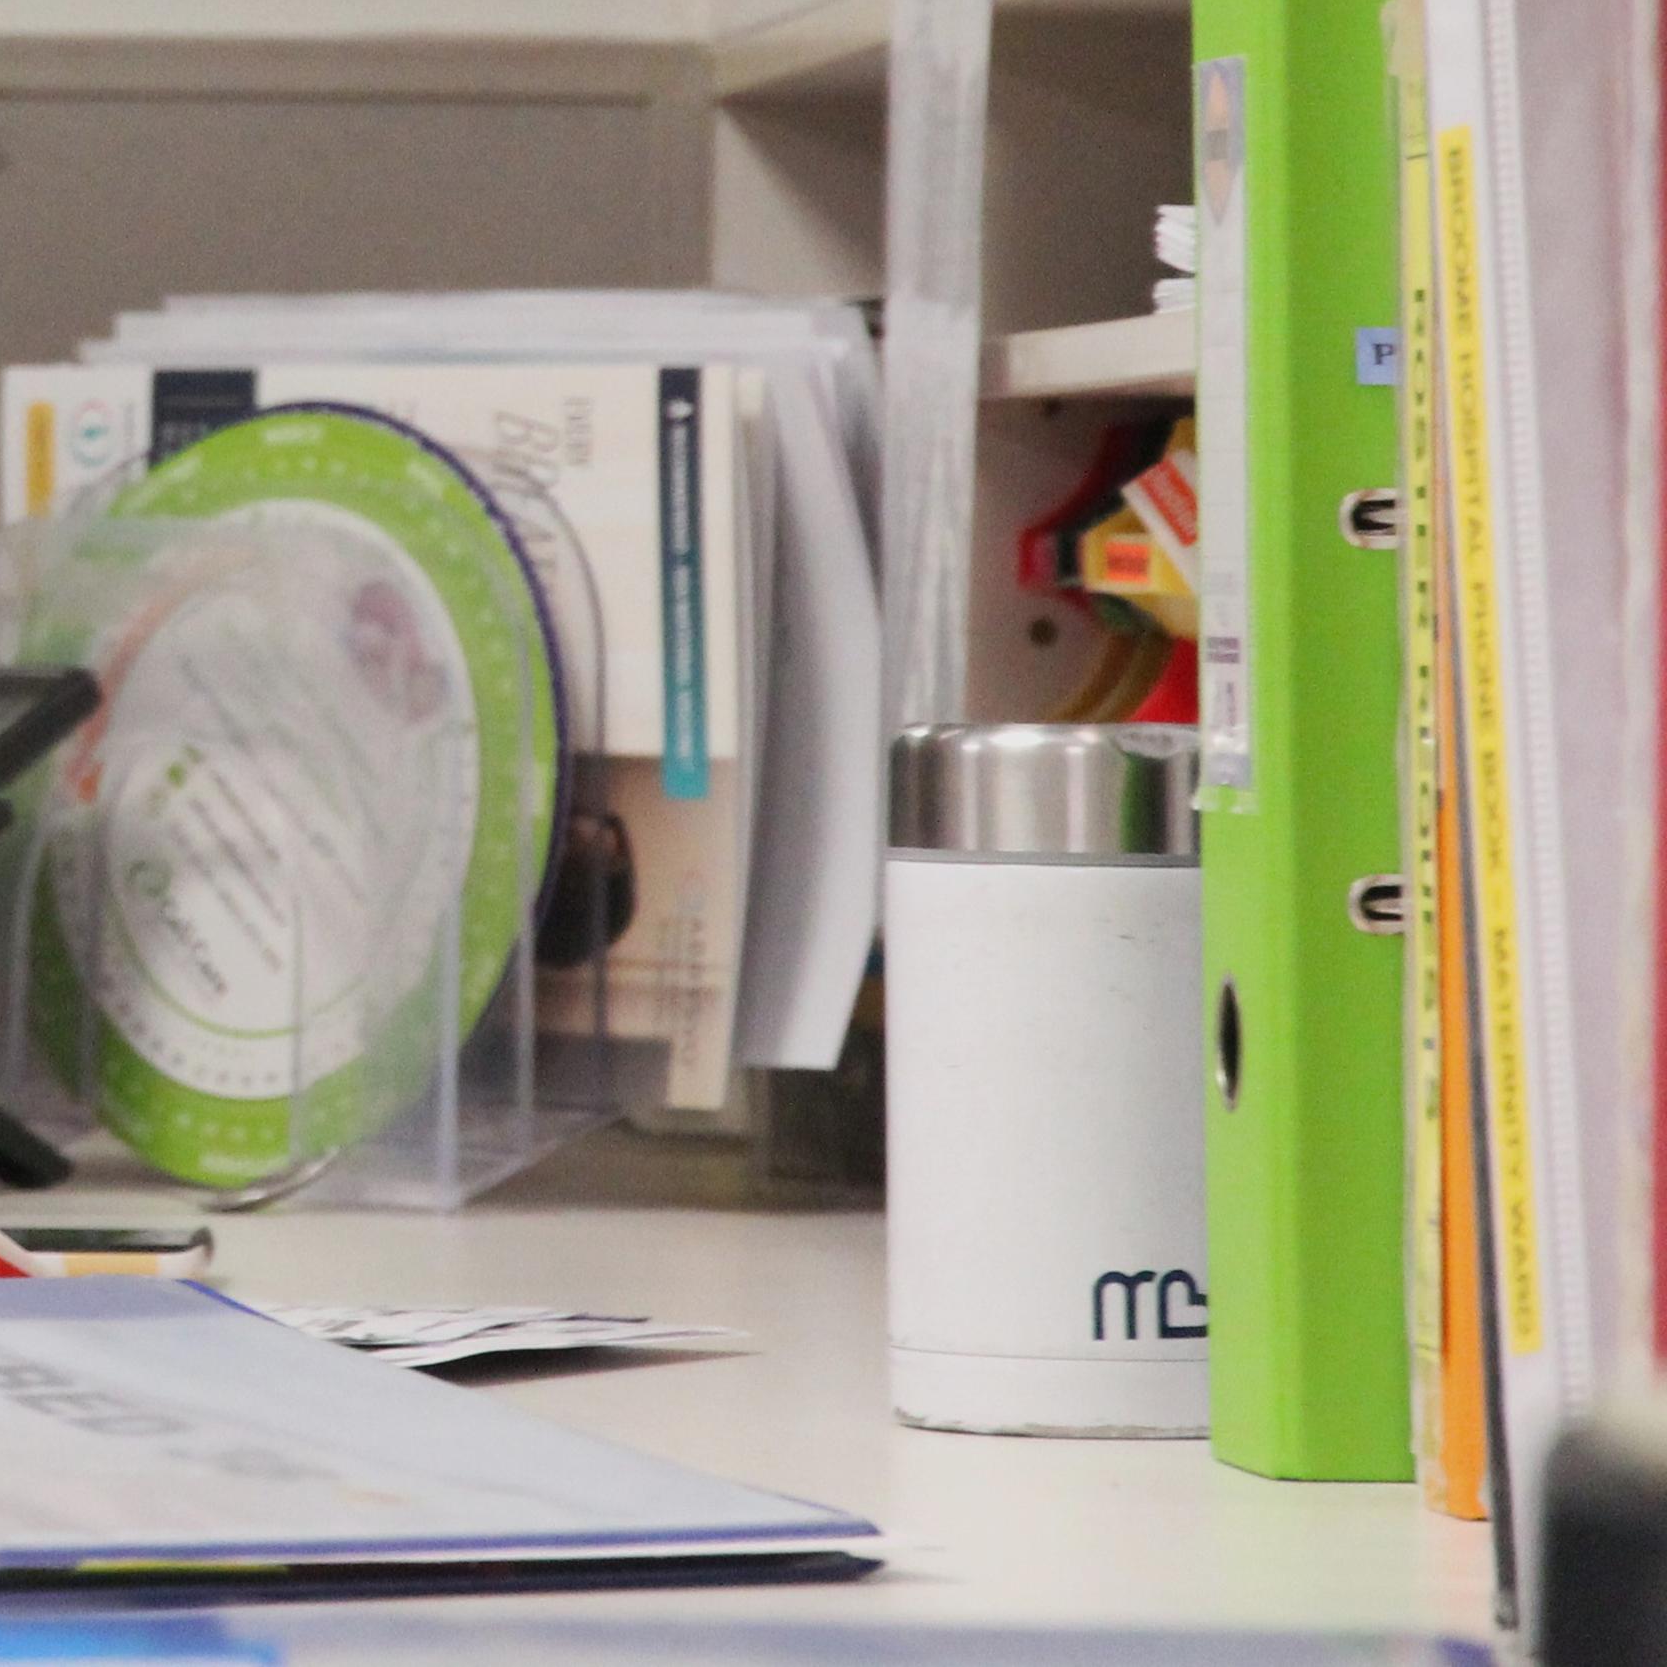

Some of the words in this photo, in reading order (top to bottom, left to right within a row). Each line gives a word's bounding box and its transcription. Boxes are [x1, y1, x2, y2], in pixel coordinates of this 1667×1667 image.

[1460, 352, 1484, 555] HOSPITAL
[1472, 582, 1496, 725] PHONE
[1482, 748, 1502, 870] BOOK
[1495, 928, 1523, 1178] MATERNITY
[1512, 1200, 1533, 1337] WARD
